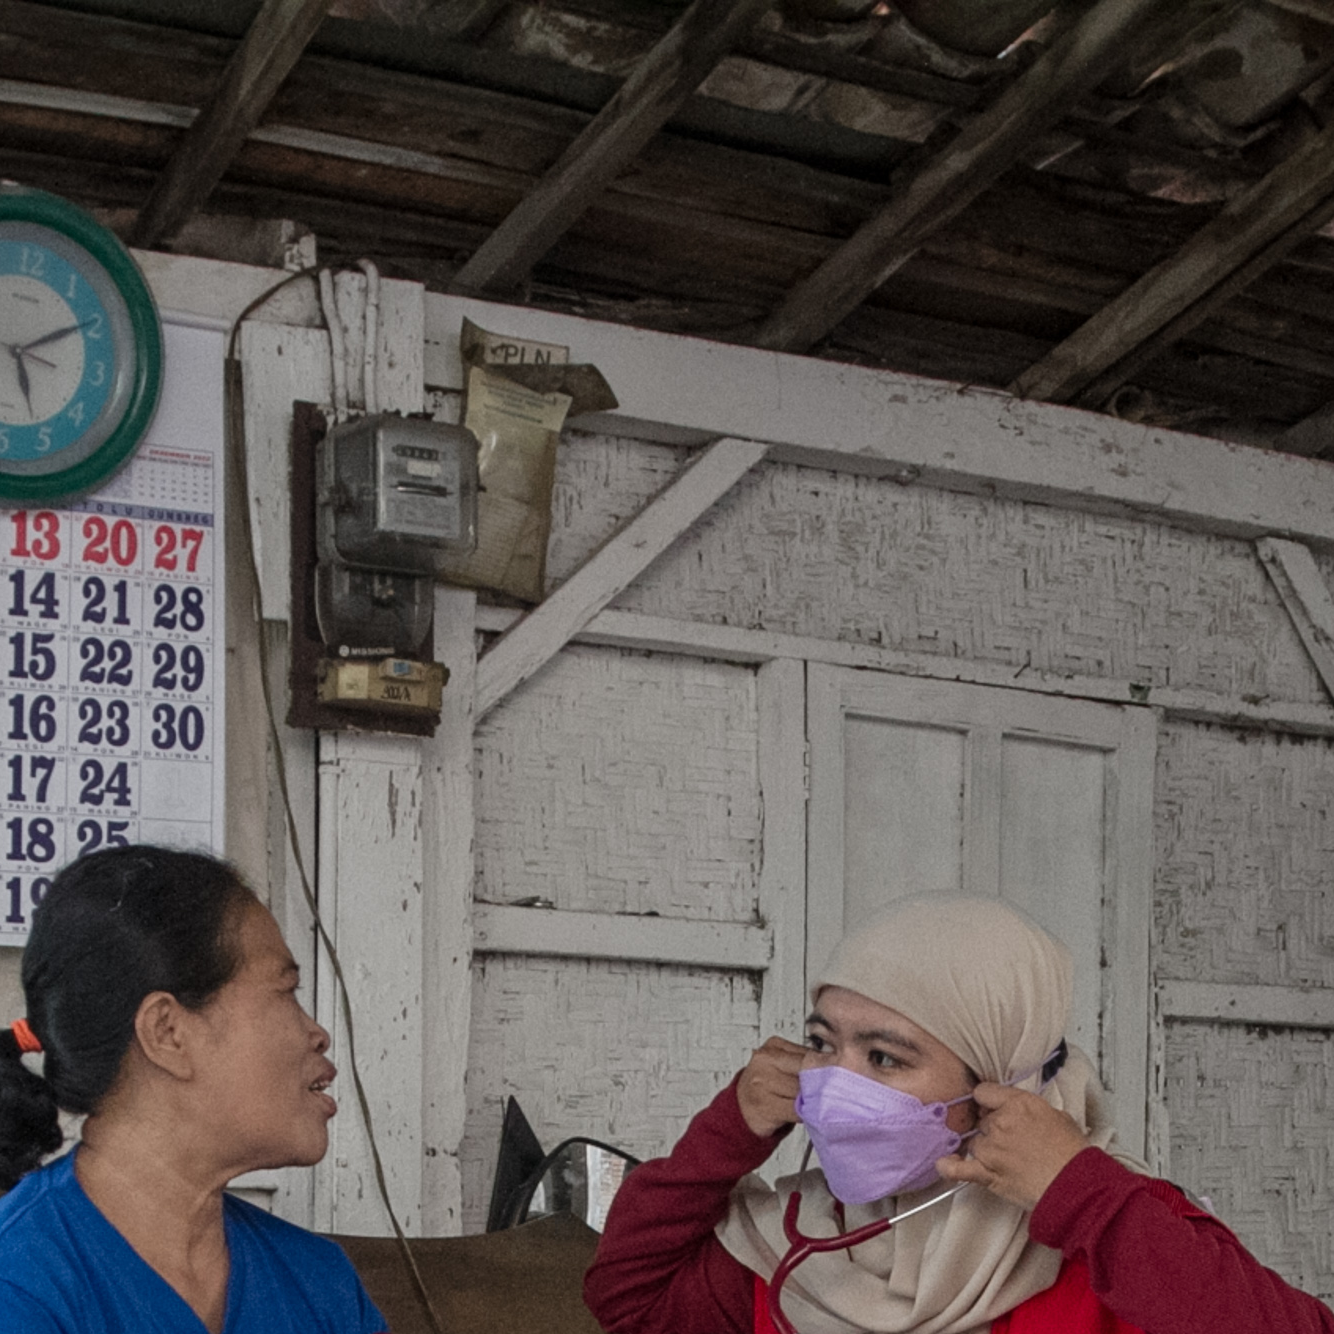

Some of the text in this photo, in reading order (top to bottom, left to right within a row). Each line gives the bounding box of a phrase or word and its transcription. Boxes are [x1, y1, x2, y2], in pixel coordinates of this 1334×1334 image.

[20, 247, 45, 276] 12
[67, 273, 77, 297] 1
[88, 314, 102, 338] 2
[503, 343, 551, 365] PLN
[91, 362, 105, 386] 3
[68, 403, 84, 427] 4
[37, 427, 53, 452] 5
[83, 501, 209, 525] TOLU GUMBREG
[10, 510, 61, 560] 13
[82, 516, 138, 567] 20
[154, 525, 204, 573] 27
[8, 569, 59, 620] 14
[82, 576, 130, 626] 21
[153, 583, 205, 632] 28
[9, 632, 56, 681] 15
[80, 637, 133, 687] 22
[153, 642, 205, 692] 29
[8, 694, 57, 743] 16
[78, 698, 130, 747] 23
[152, 703, 205, 752] 30
[7, 755, 56, 803] 17
[79, 759, 132, 807] 24
[6, 817, 56, 863] 18
[77, 819, 130, 859] 25
